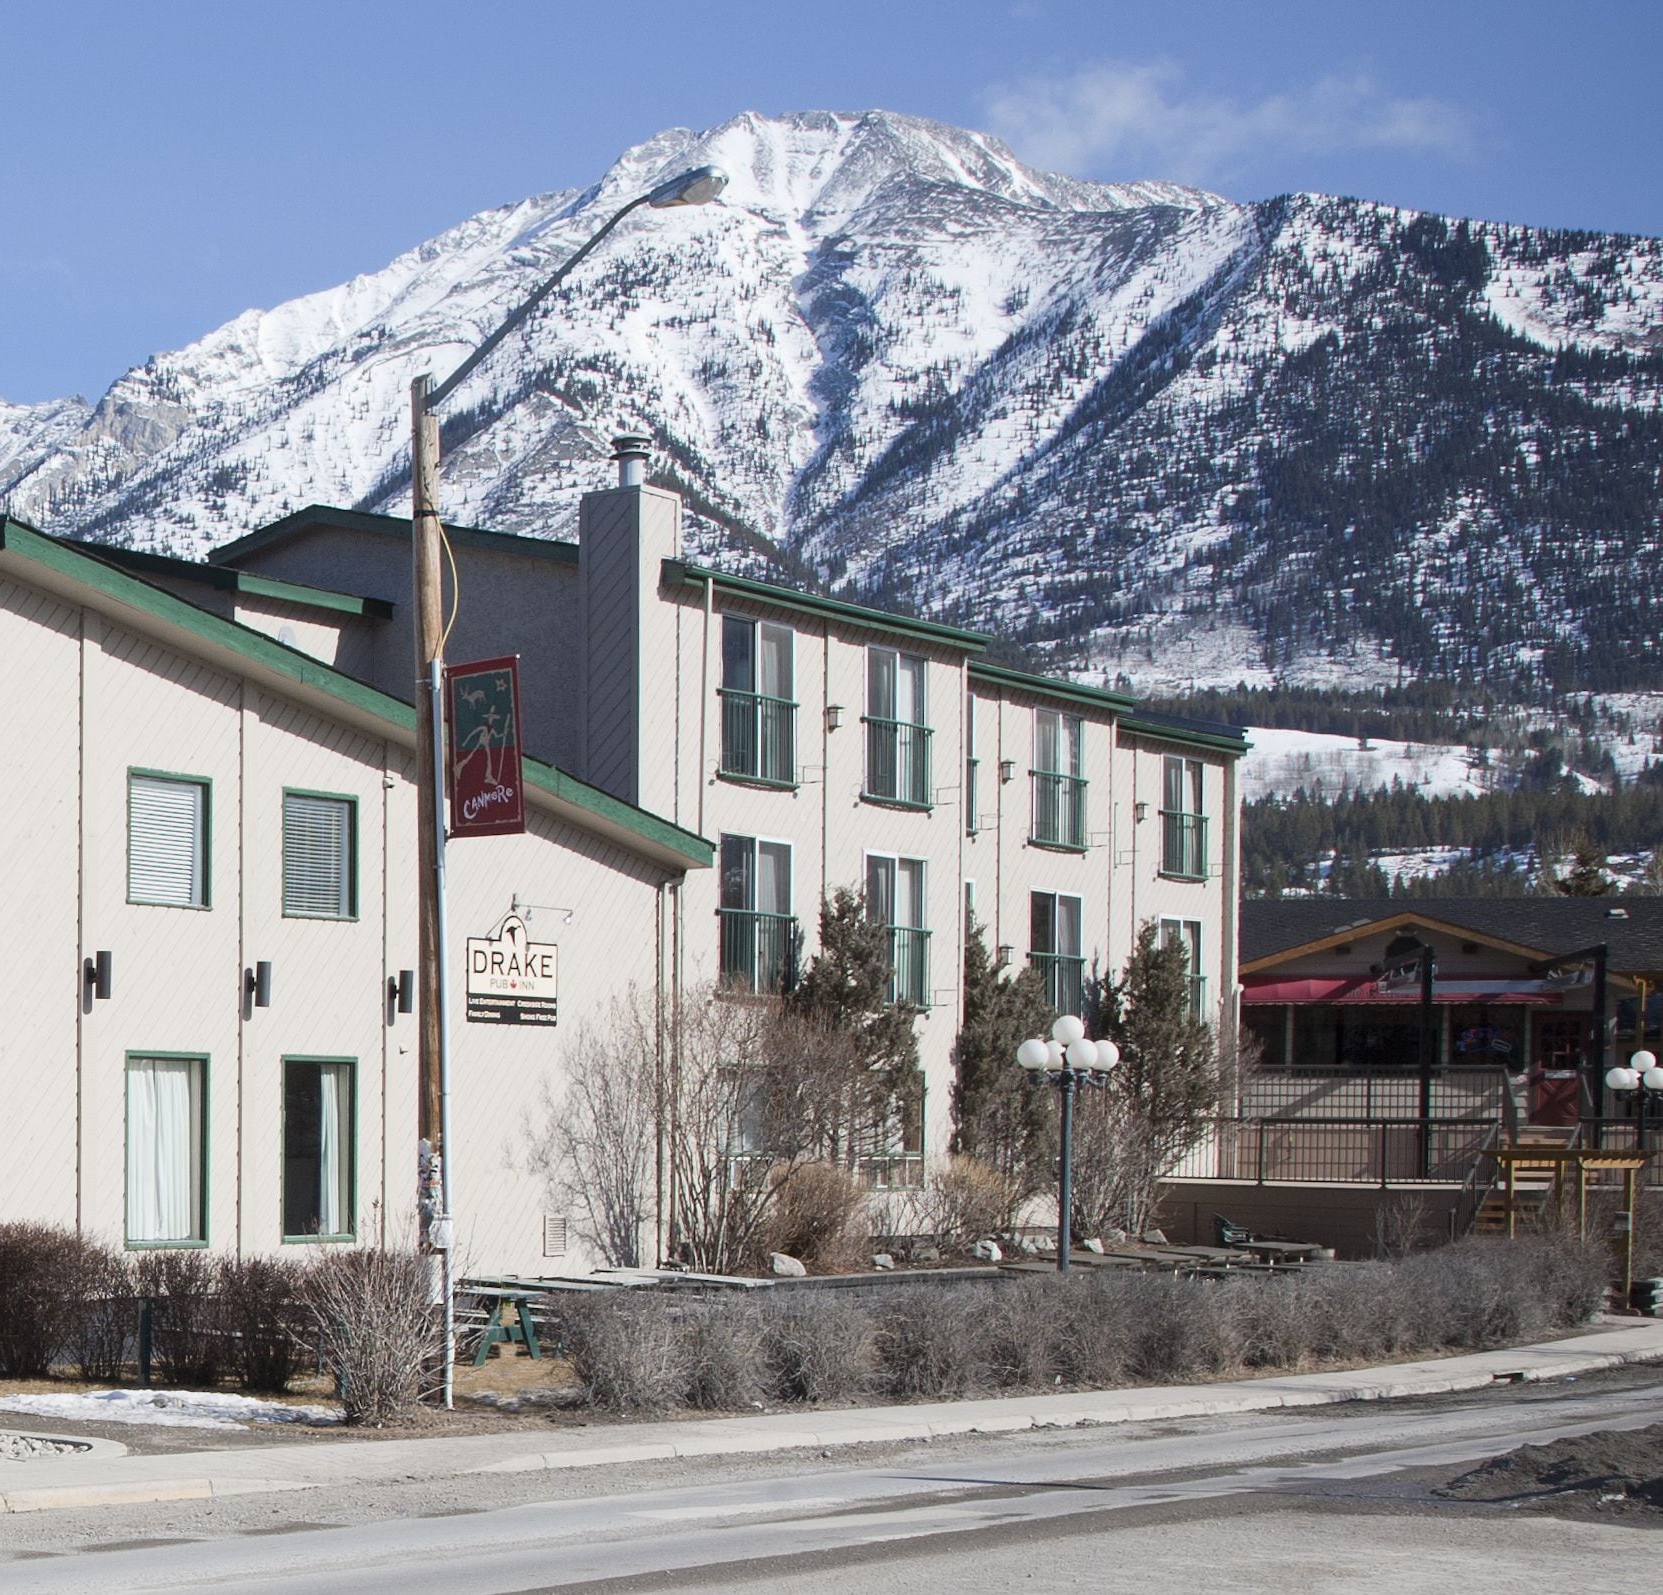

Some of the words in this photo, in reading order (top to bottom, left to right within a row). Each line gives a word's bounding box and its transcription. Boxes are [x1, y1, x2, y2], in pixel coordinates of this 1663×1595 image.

[474, 950, 553, 978] DRAKE
[490, 979, 508, 989] PUB
[520, 981, 535, 991] INN
